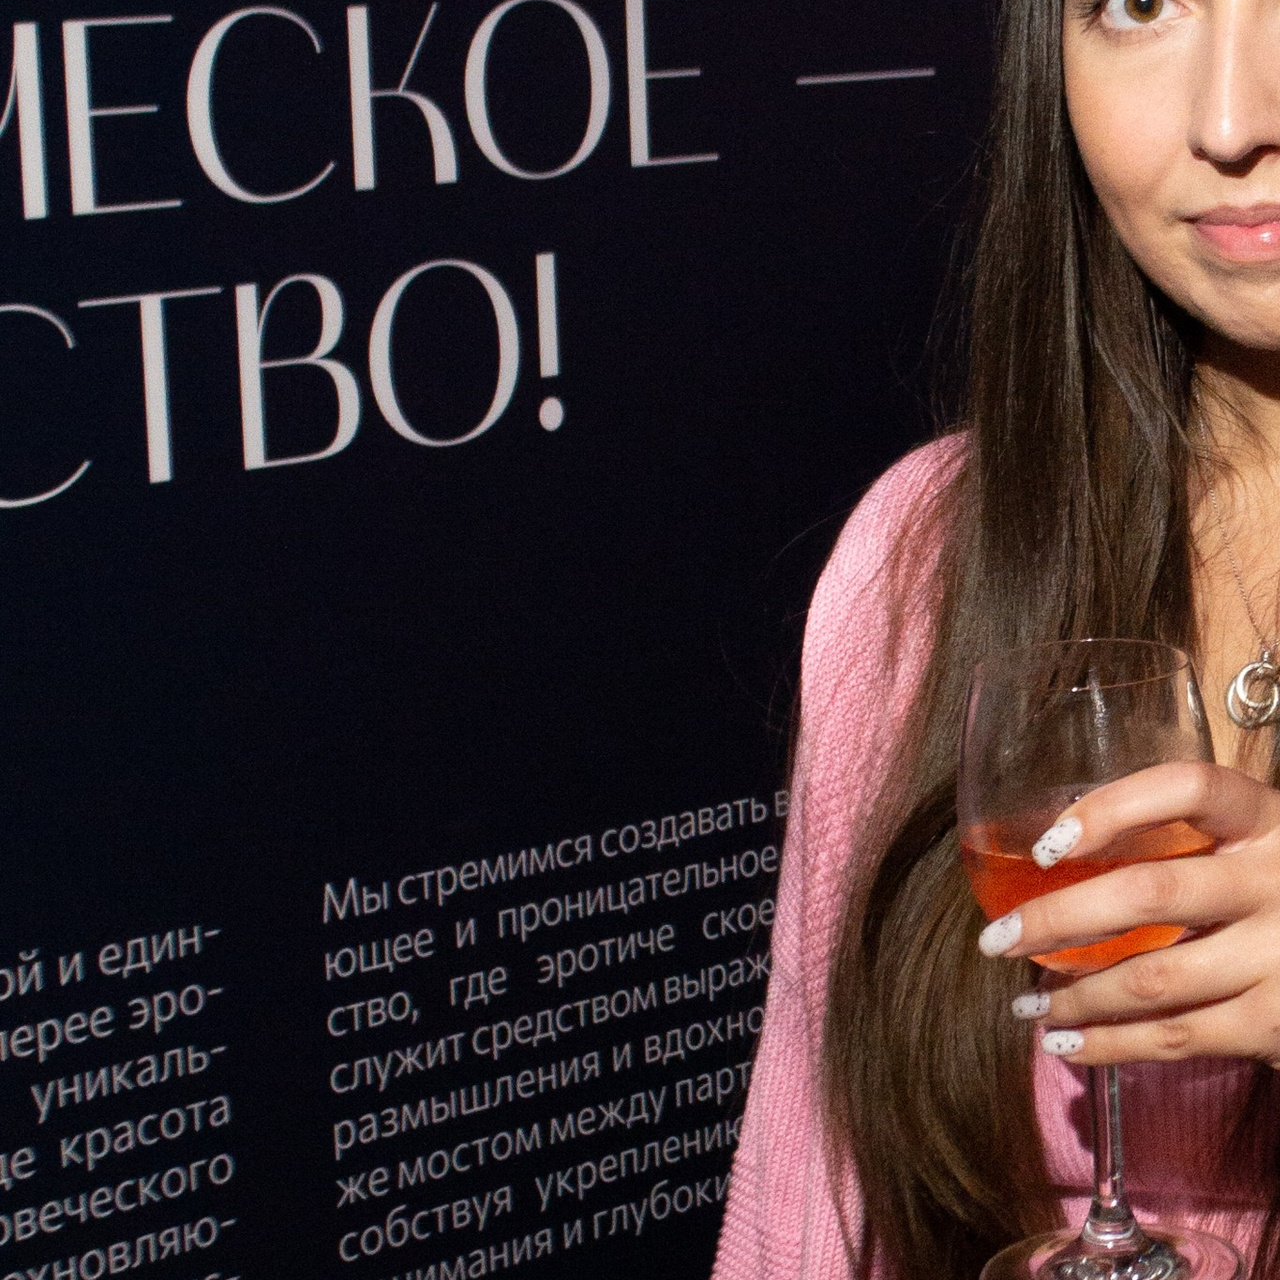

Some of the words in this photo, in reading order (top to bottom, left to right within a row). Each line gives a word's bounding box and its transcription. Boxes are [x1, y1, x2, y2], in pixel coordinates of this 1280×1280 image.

[322, 877, 390, 924] Мы
[397, 834, 593, 907] стремимся
[600, 797, 768, 858] создавать
[58, 951, 85, 986] и
[97, 925, 221, 979] един-
[324, 928, 435, 981] ющее
[455, 917, 477, 949] и
[498, 844, 778, 943] проницательное
[127, 984, 224, 1034] эро-
[326, 990, 420, 1037] ство,
[449, 966, 508, 1010] где
[537, 924, 675, 988] эротиче
[702, 898, 776, 940] ское
[30, 1045, 227, 1124] уникаль-
[330, 1032, 466, 1094] служит
[471, 982, 657, 1060] средством
[60, 1095, 232, 1172] красота
[333, 1051, 601, 1161] размышления
[613, 1043, 632, 1072] и
[336, 1166, 390, 1208] же
[398, 1123, 542, 1189] мостом
[550, 1086, 667, 1144] между
[338, 1185, 513, 1262] собствуя
[563, 1219, 583, 1249] и
